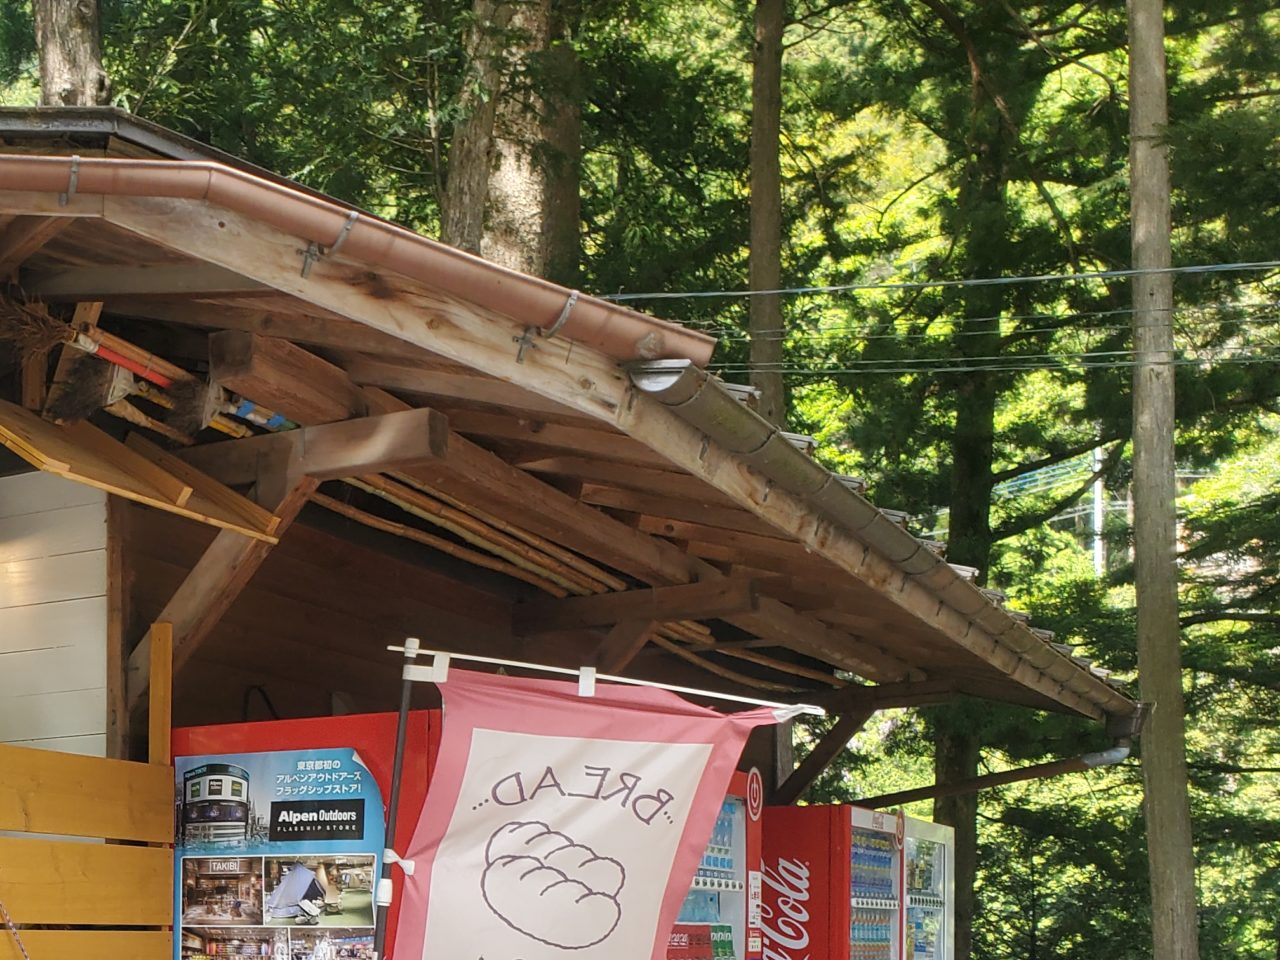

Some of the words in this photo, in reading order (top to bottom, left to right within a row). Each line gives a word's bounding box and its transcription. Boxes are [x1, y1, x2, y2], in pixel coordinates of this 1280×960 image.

[296, 760, 341, 771] 東京都初の
[276, 771, 362, 784] アルペンアウトドアーズ
[278, 810, 318, 825] Alpen
[319, 809, 357, 822] Outdoors
